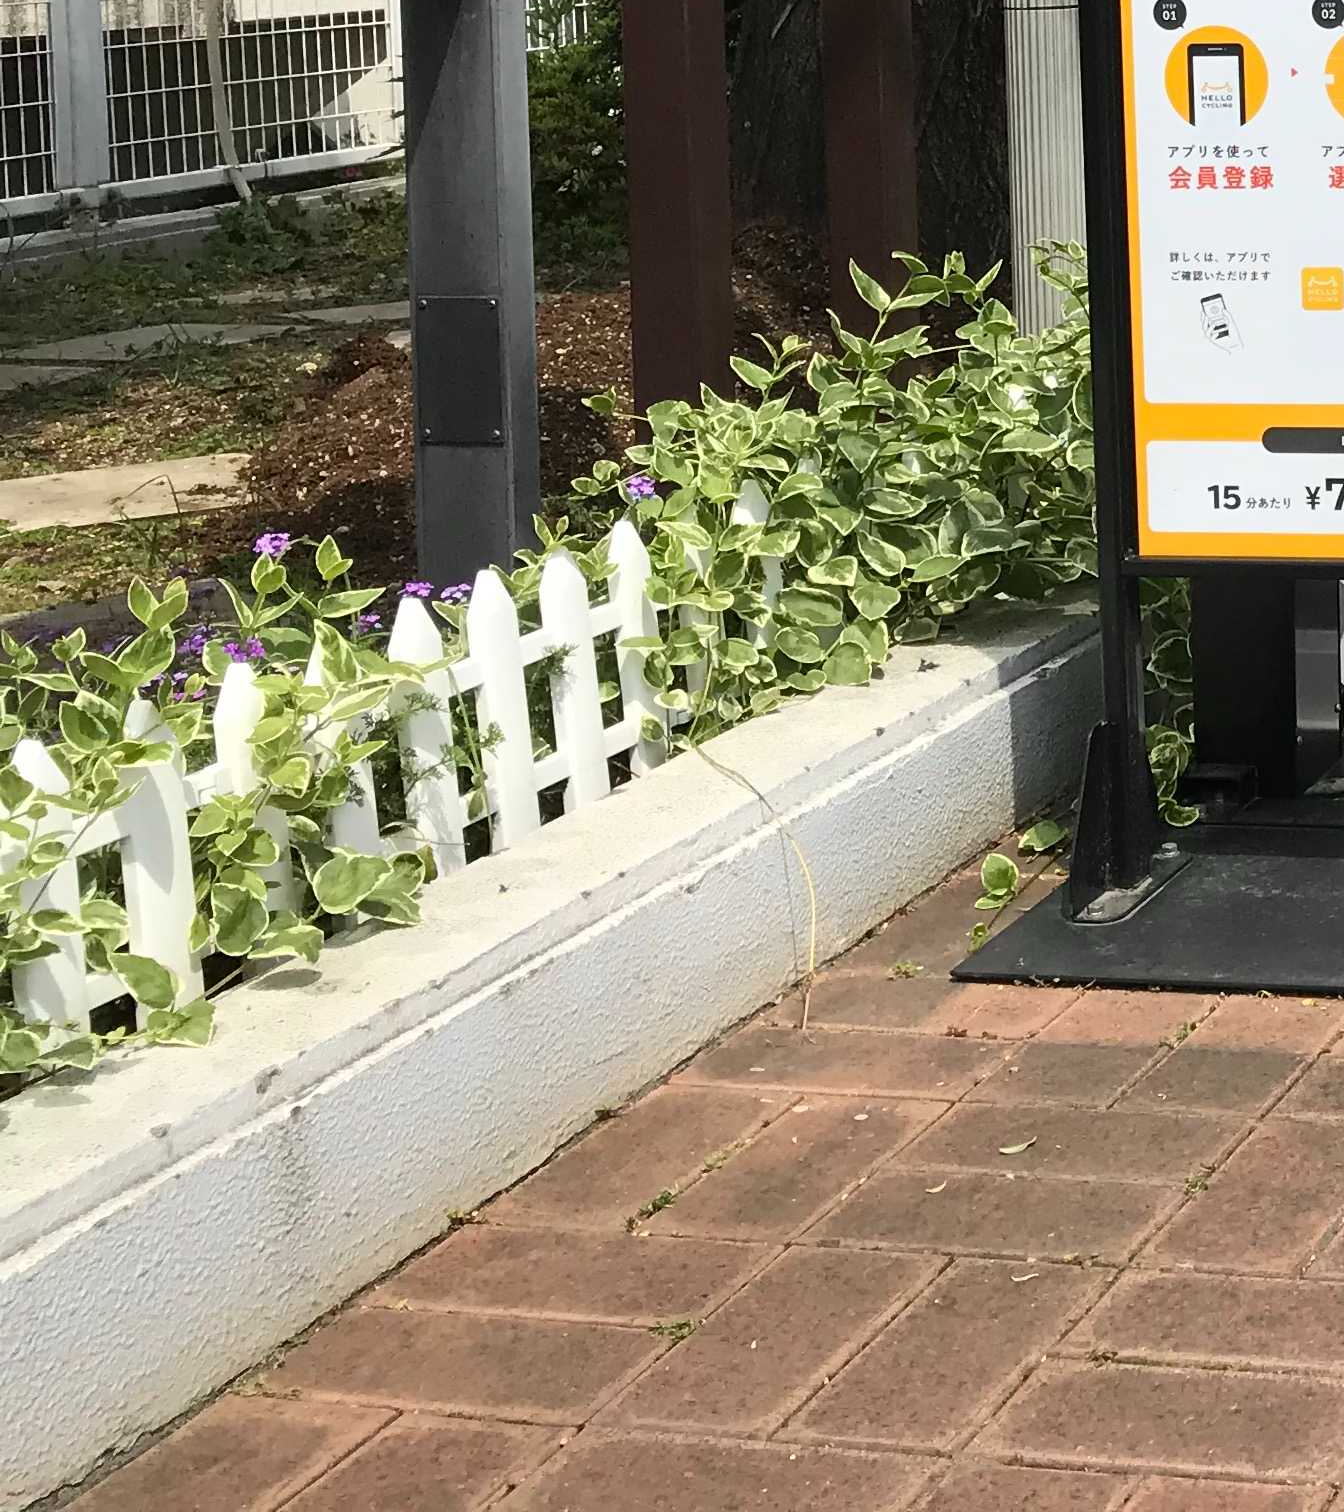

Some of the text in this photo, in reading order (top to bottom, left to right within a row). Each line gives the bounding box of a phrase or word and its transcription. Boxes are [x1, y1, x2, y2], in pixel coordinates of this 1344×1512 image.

[1162, 10, 1177, 21] 01
[1320, 8, 1337, 20] 02
[1201, 94, 1233, 102] HELLO
[1167, 145, 1270, 159] アプリを使って
[1168, 165, 1275, 190] 会員登録
[1169, 252, 1271, 263] 詳しくは、アプリで
[1170, 270, 1272, 282] ご確認いただけます
